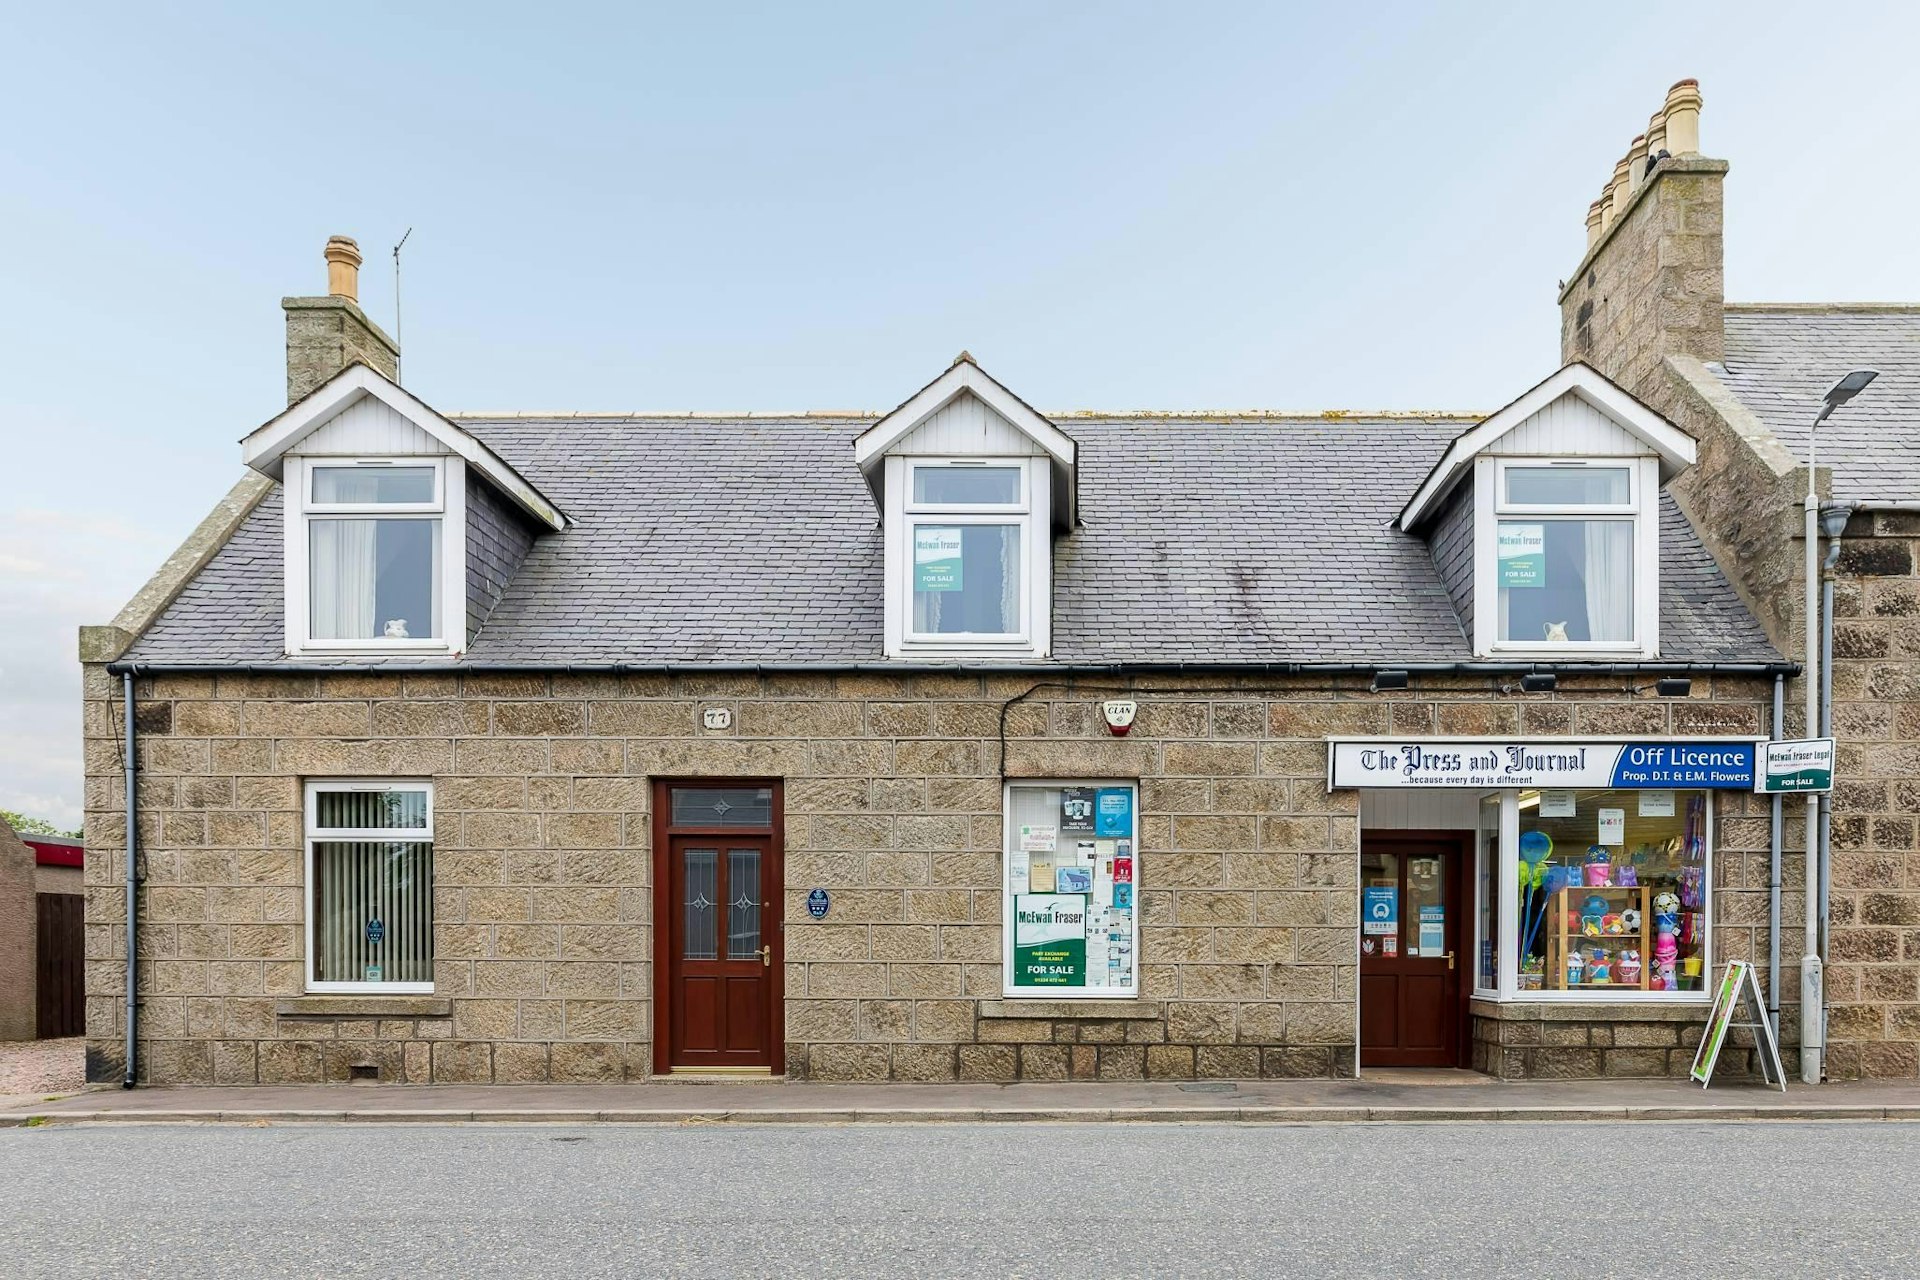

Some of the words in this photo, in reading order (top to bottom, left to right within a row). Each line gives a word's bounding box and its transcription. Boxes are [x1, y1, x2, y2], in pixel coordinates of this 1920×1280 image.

[1108, 706, 1130, 714] CLAN
[706, 713, 726, 724] 77
[1360, 749, 1398, 771] The
[1401, 745, 1461, 777] Press
[1469, 749, 1498, 771] and
[1505, 745, 1586, 774] Journal
[1630, 747, 1665, 766] Off
[1671, 747, 1745, 766] Licence
[1769, 753, 1791, 762] McEwan
[1794, 752, 1813, 761] Fraser
[1814, 750, 1830, 761] Legal
[1446, 777, 1468, 786] every
[1470, 775, 1485, 786] day
[1487, 775, 1494, 784] is
[1496, 775, 1533, 784] different
[1622, 771, 1649, 783] Prop.
[1652, 771, 1670, 781] D.T.
[1673, 771, 1682, 781] &
[1685, 771, 1707, 781] E.M.
[1710, 771, 1750, 782] Flowers
[1018, 911, 1052, 924] McEwan
[1055, 911, 1083, 924] Fraser
[1027, 965, 1047, 974] FOR
[1049, 965, 1074, 974] SALE
